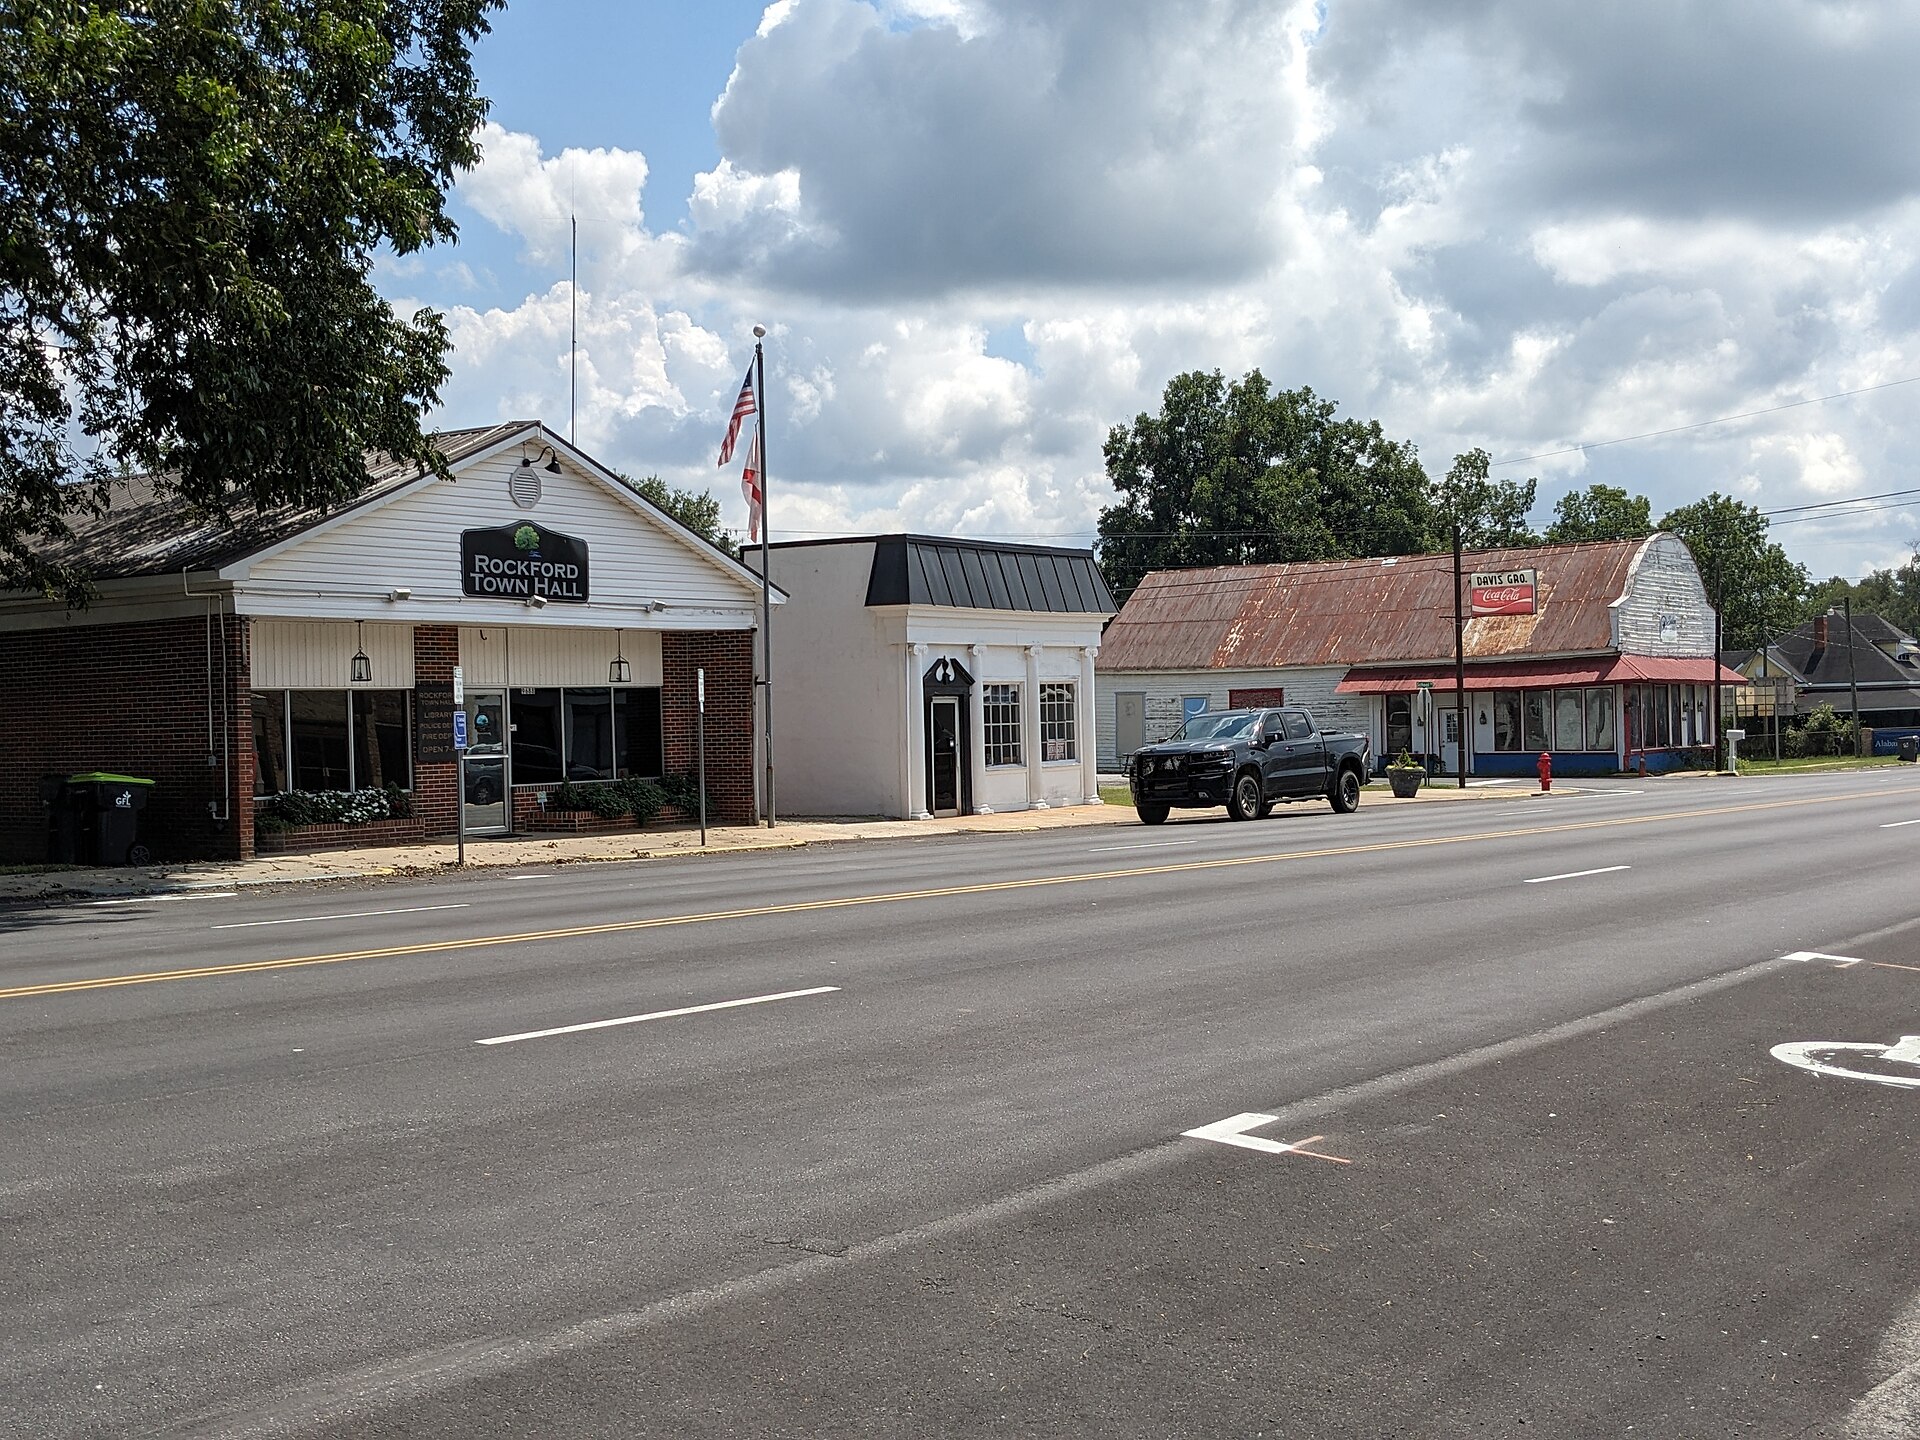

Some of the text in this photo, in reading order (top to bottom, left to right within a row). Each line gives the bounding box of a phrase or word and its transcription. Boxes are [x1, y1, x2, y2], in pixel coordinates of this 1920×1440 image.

[474, 554, 579, 579] ROCKFORD
[470, 572, 583, 597] TOWN HALL
[1476, 573, 1528, 586] DAVIS GRO.
[424, 711, 453, 719] LIBRARY
[438, 732, 453, 740] DEP
[422, 745, 444, 754] OPEN
[115, 796, 131, 806] GFL
